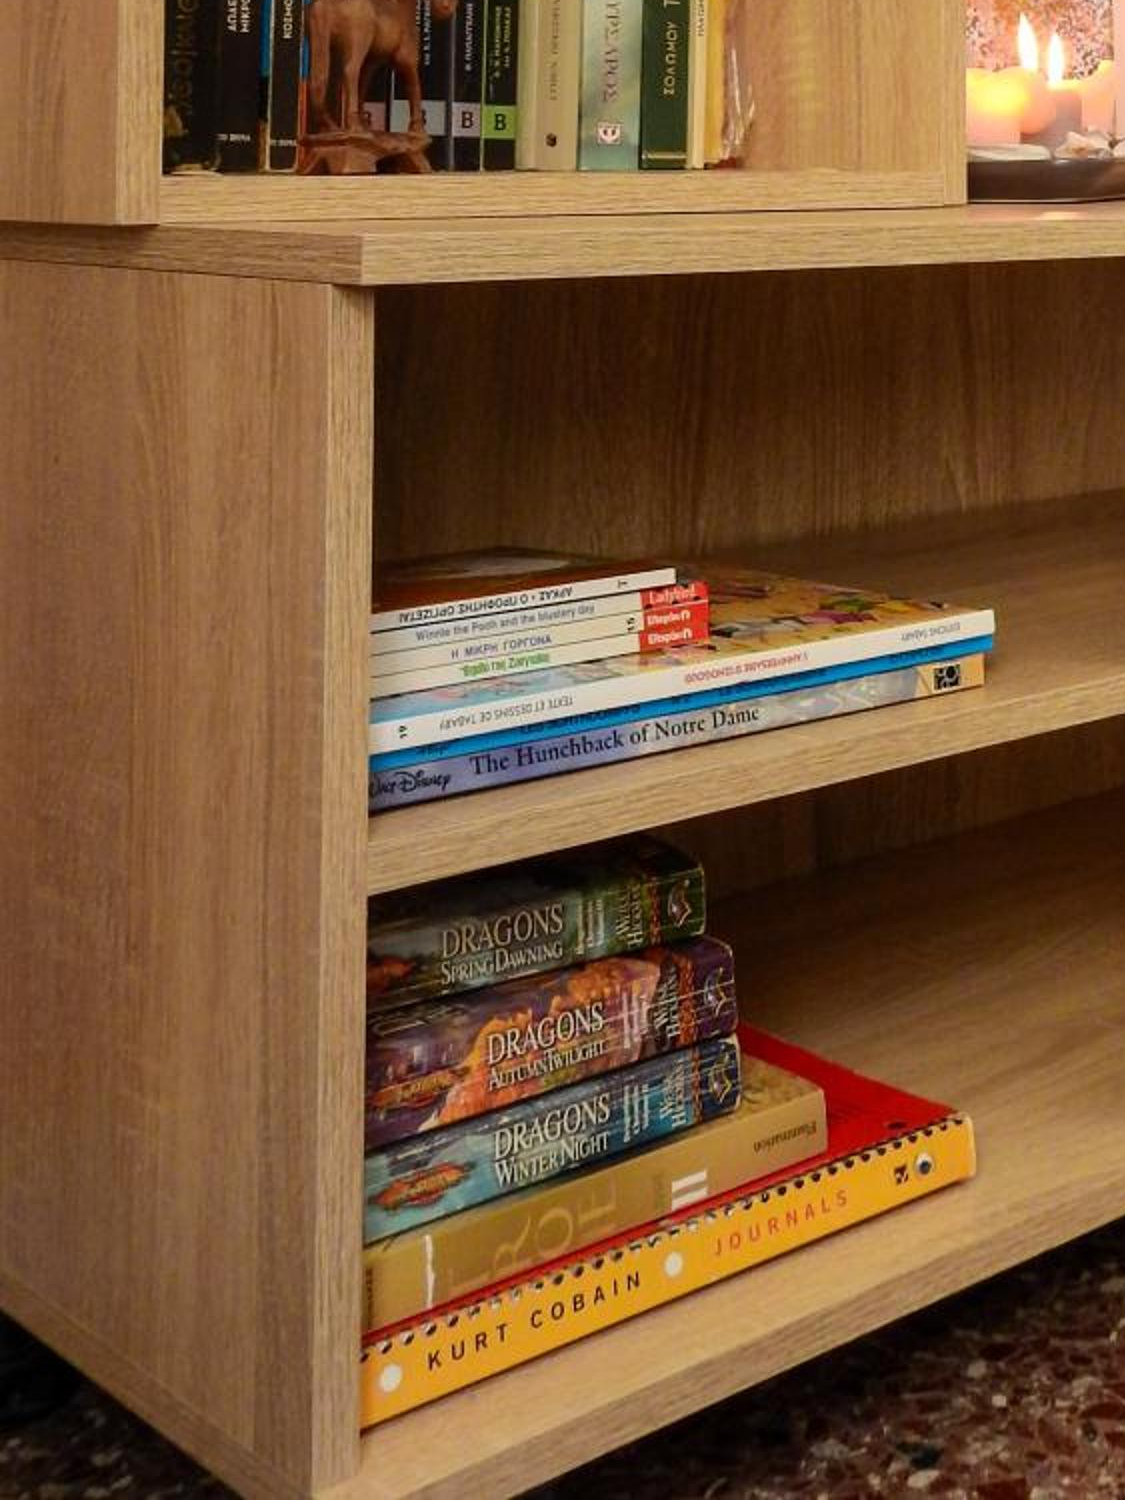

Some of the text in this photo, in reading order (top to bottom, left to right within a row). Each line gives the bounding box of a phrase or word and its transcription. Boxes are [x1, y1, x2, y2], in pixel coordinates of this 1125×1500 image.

[662, 21, 679, 96] ΣΟΛΩΜΟΥ
[460, 597, 520, 615] ΠΡΟΦΗΤΗΣ
[469, 753, 510, 776] The
[515, 731, 624, 770] Hunchback
[628, 722, 650, 745] of
[655, 714, 707, 744] Notre
[712, 706, 761, 730] Dame
[441, 903, 564, 959] DRAGONS
[487, 1001, 605, 1066] DRAGONS
[494, 1131, 609, 1188] WINTER NIGHT
[495, 1091, 611, 1160] DRAGONS
[713, 1188, 851, 1256] JOURNALS
[426, 1268, 645, 1370] KURT COBAIN
